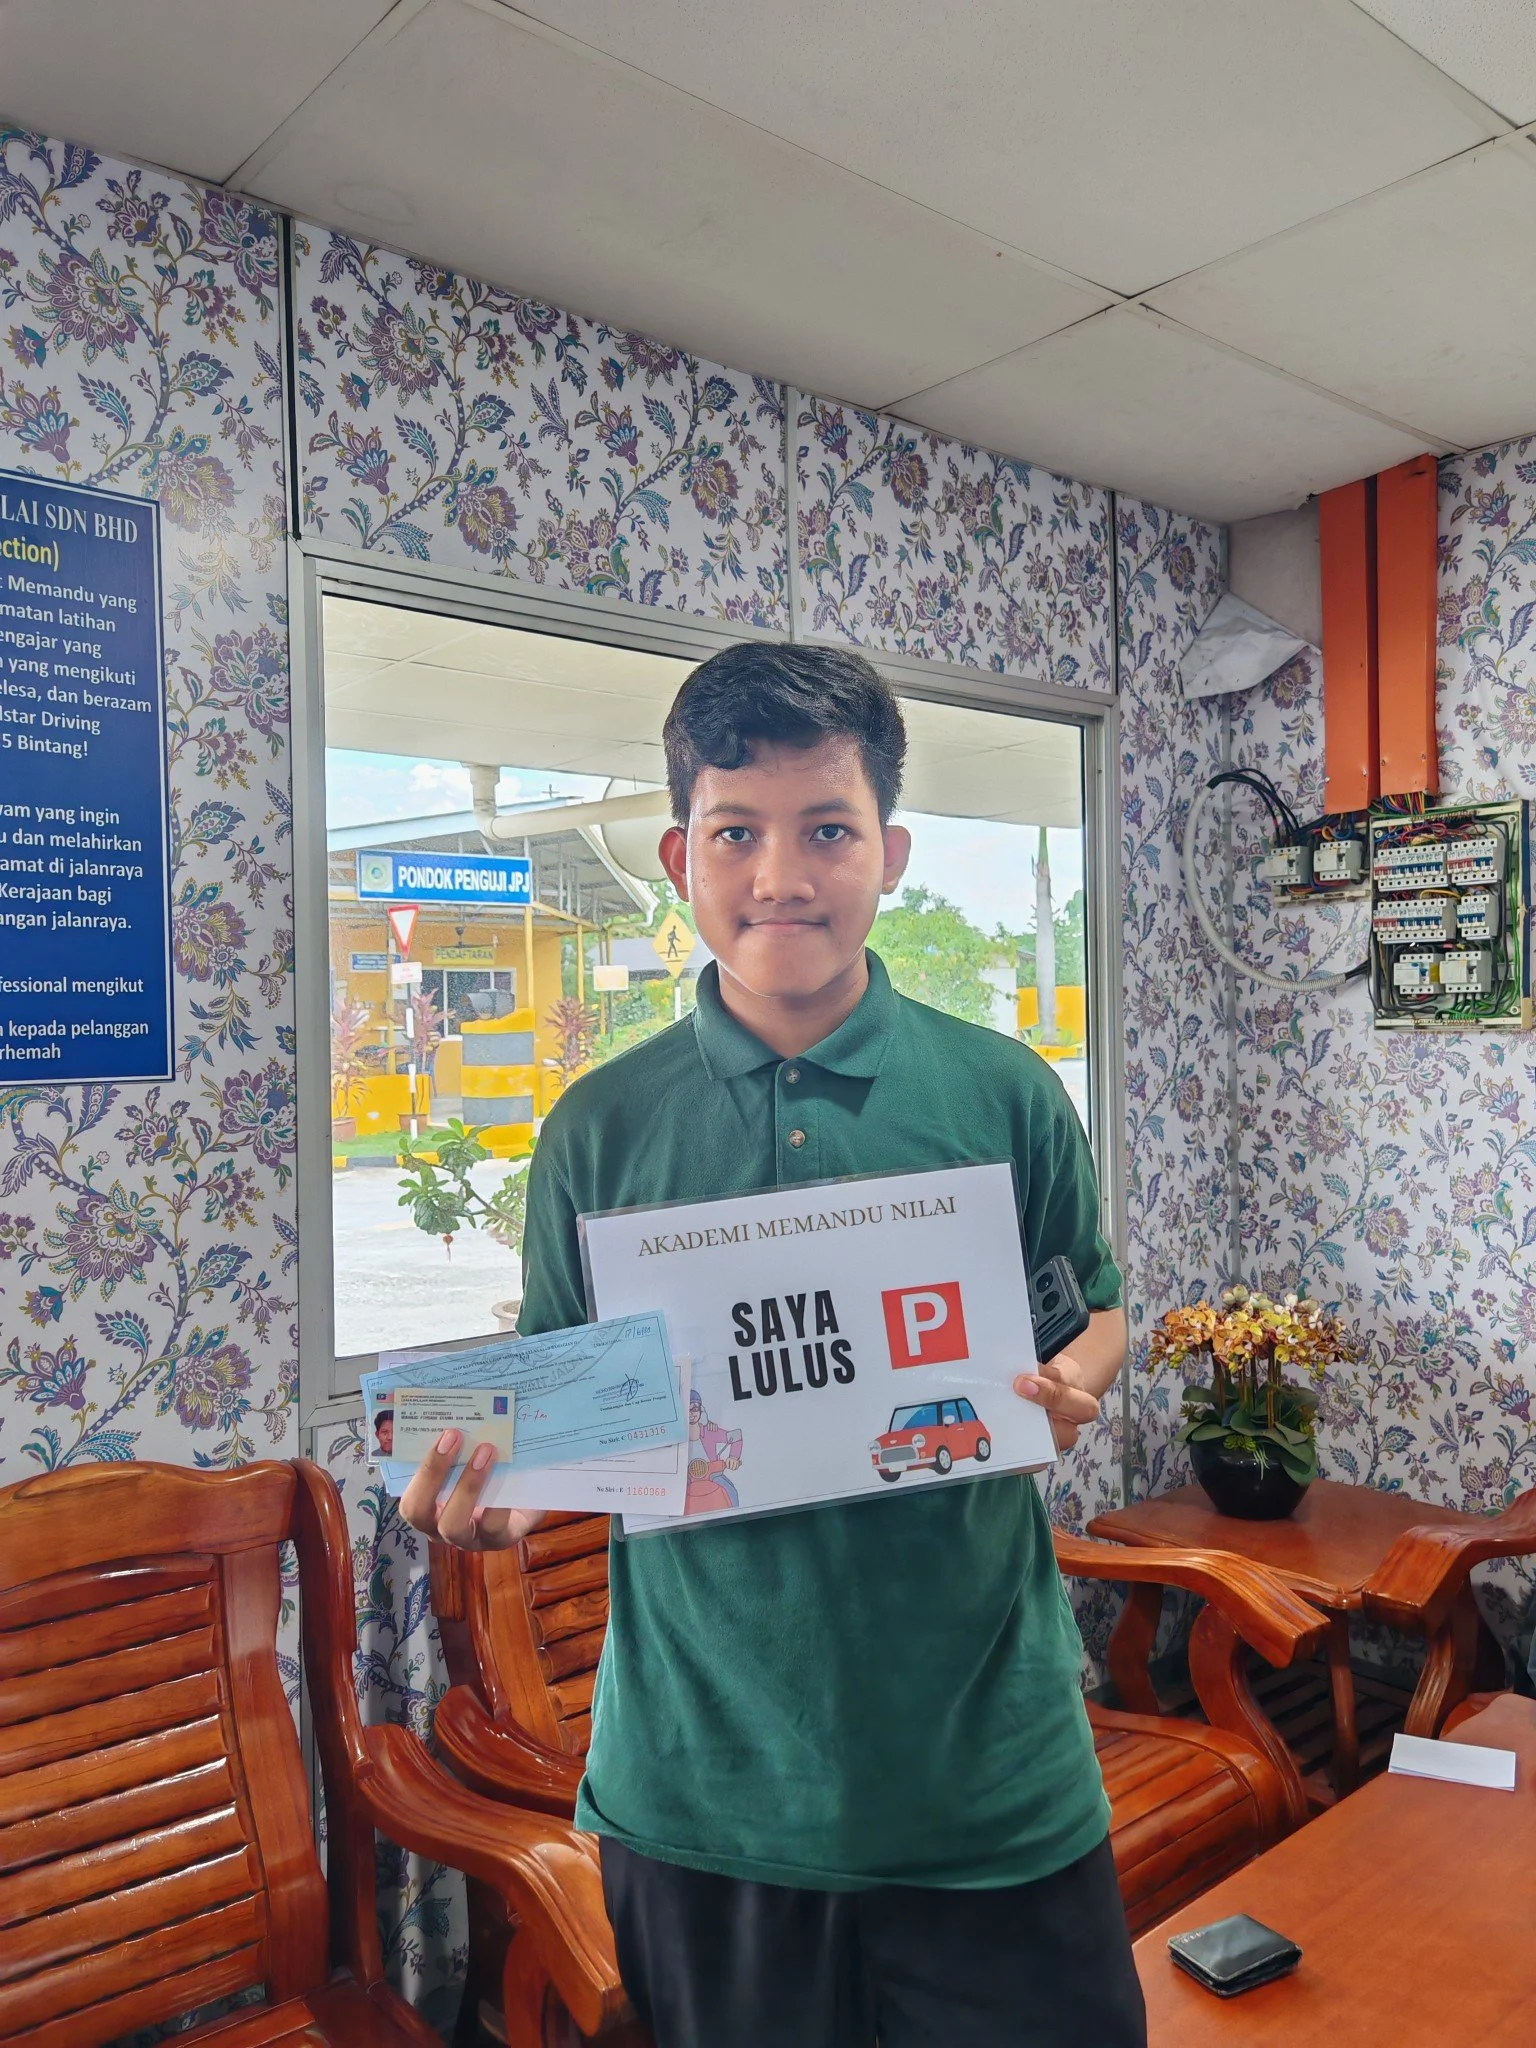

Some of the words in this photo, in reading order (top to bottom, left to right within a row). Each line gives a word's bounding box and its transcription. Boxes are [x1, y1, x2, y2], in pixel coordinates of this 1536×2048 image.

[0, 494, 38, 526] LAI
[45, 503, 87, 535] SDN
[94, 512, 138, 544] BHD
[0, 536, 59, 572] ction)
[8, 574, 94, 603] Memandu
[99, 592, 137, 613] yang
[59, 608, 116, 633] latihan
[62, 639, 102, 659] yang
[8, 657, 48, 677] yang
[54, 661, 136, 686] mengikuti
[47, 685, 78, 704] dan
[83, 688, 152, 713] berazam
[41, 709, 100, 735] Driving
[2, 732, 12, 748] 5
[18, 734, 88, 760] Bintang!
[35, 806, 75, 825] yang
[80, 806, 119, 827] ingin
[12, 827, 44, 846] dan
[50, 831, 141, 852] melahirkan
[0, 857, 44, 873] amat
[49, 857, 63, 874] di
[69, 858, 142, 880] jalanraya
[398, 865, 453, 890] PONDOK
[454, 868, 507, 893] PENGUJI
[508, 872, 529, 893] JPJ
[0, 882, 71, 903] Kerajaan
[77, 884, 111, 905] bagi
[52, 911, 132, 931] jalanraya.
[72, 977, 143, 996] mengikut
[9, 1019, 66, 1040] kepada
[71, 1018, 148, 1039] pelanggan
[638, 1223, 750, 1257] AKADEMI
[756, 1205, 883, 1240] MEMANDU
[890, 1196, 957, 1221] NILAI
[731, 1289, 840, 1348] SAYA
[901, 1291, 949, 1357] P
[728, 1338, 856, 1401] LULUS
[627, 1425, 666, 1441] 0431316
